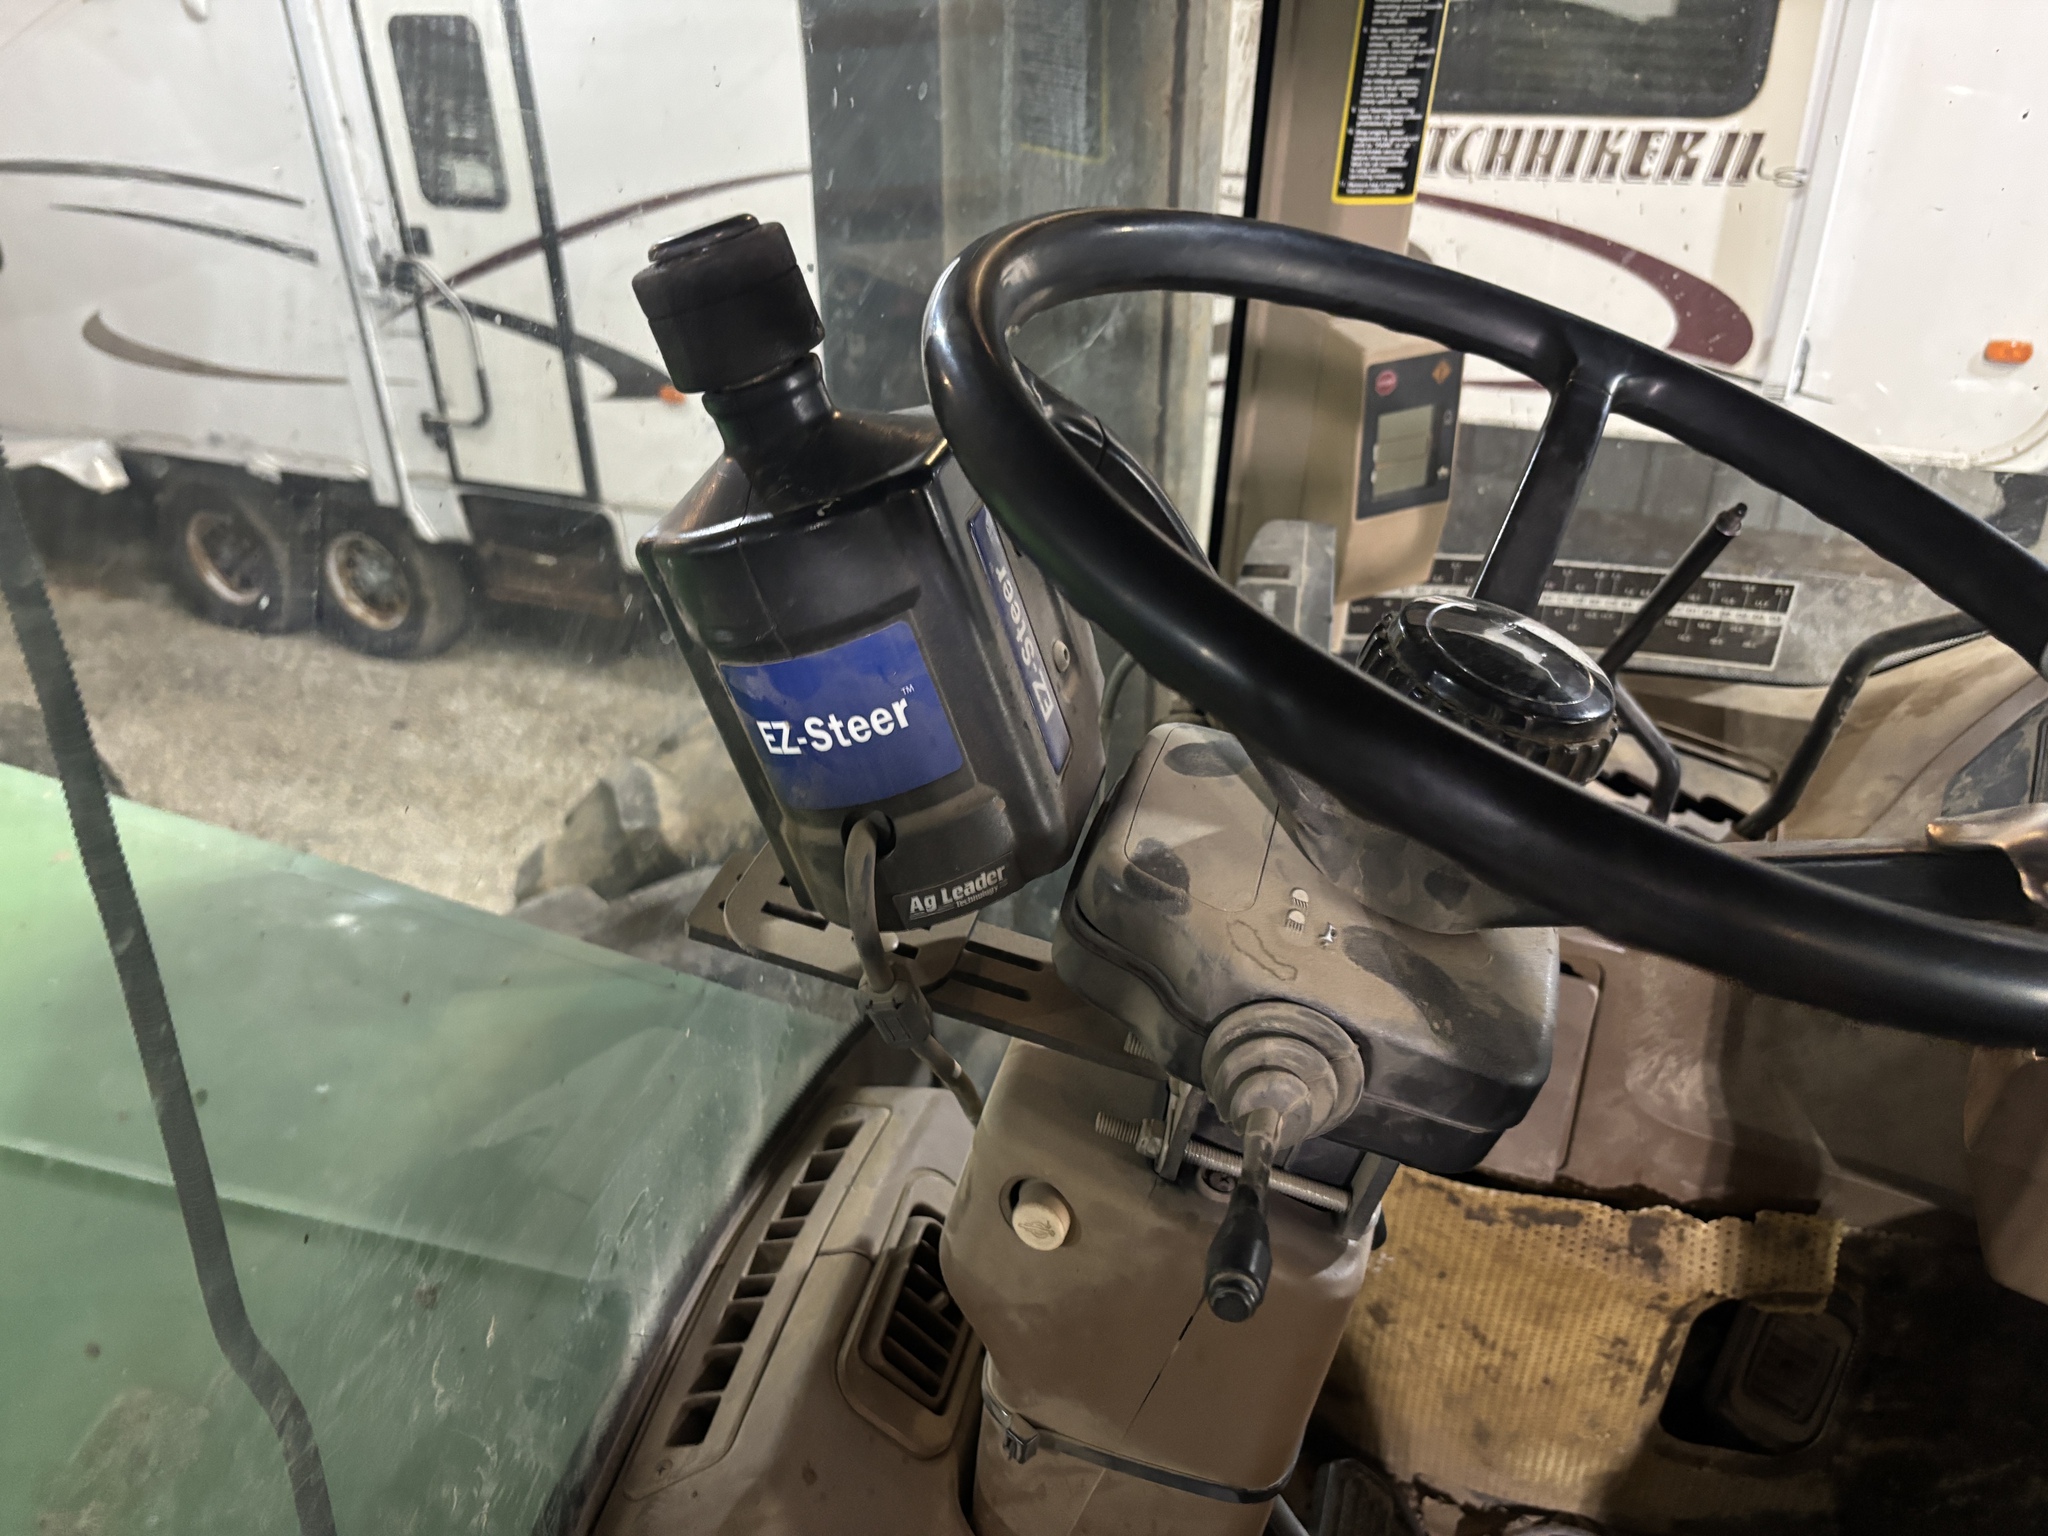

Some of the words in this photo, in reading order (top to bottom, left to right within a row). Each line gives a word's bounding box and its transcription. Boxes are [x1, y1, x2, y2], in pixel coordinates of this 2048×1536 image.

[995, 566, 1054, 723] EZ-Steer
[756, 698, 909, 755] EZ-Steer
[910, 895, 937, 913] Ag
[941, 865, 1005, 904] Leader
